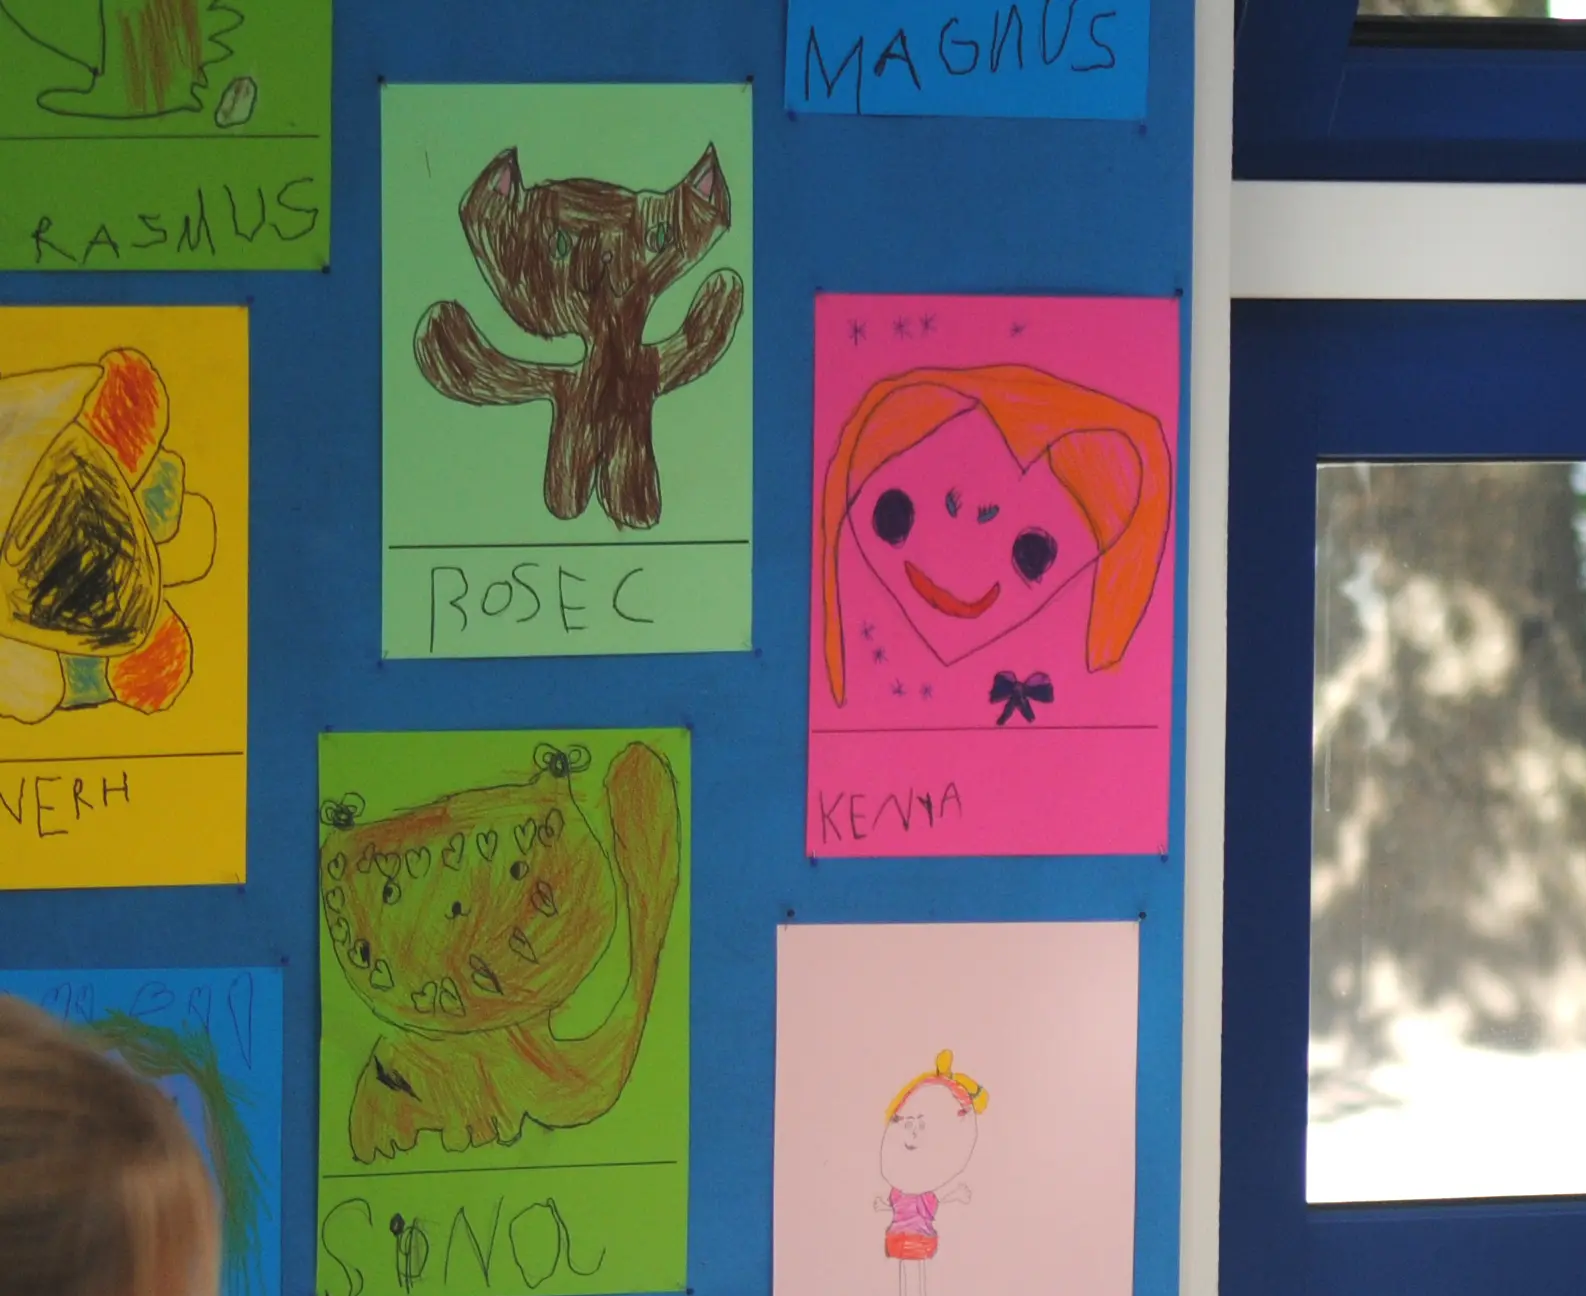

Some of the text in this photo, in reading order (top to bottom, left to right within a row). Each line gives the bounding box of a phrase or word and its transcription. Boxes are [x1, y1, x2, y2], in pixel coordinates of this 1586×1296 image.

[803, 0, 1117, 115] MAGNUS
[31, 177, 319, 265] RASMUS
[819, 781, 963, 845] KENYA
